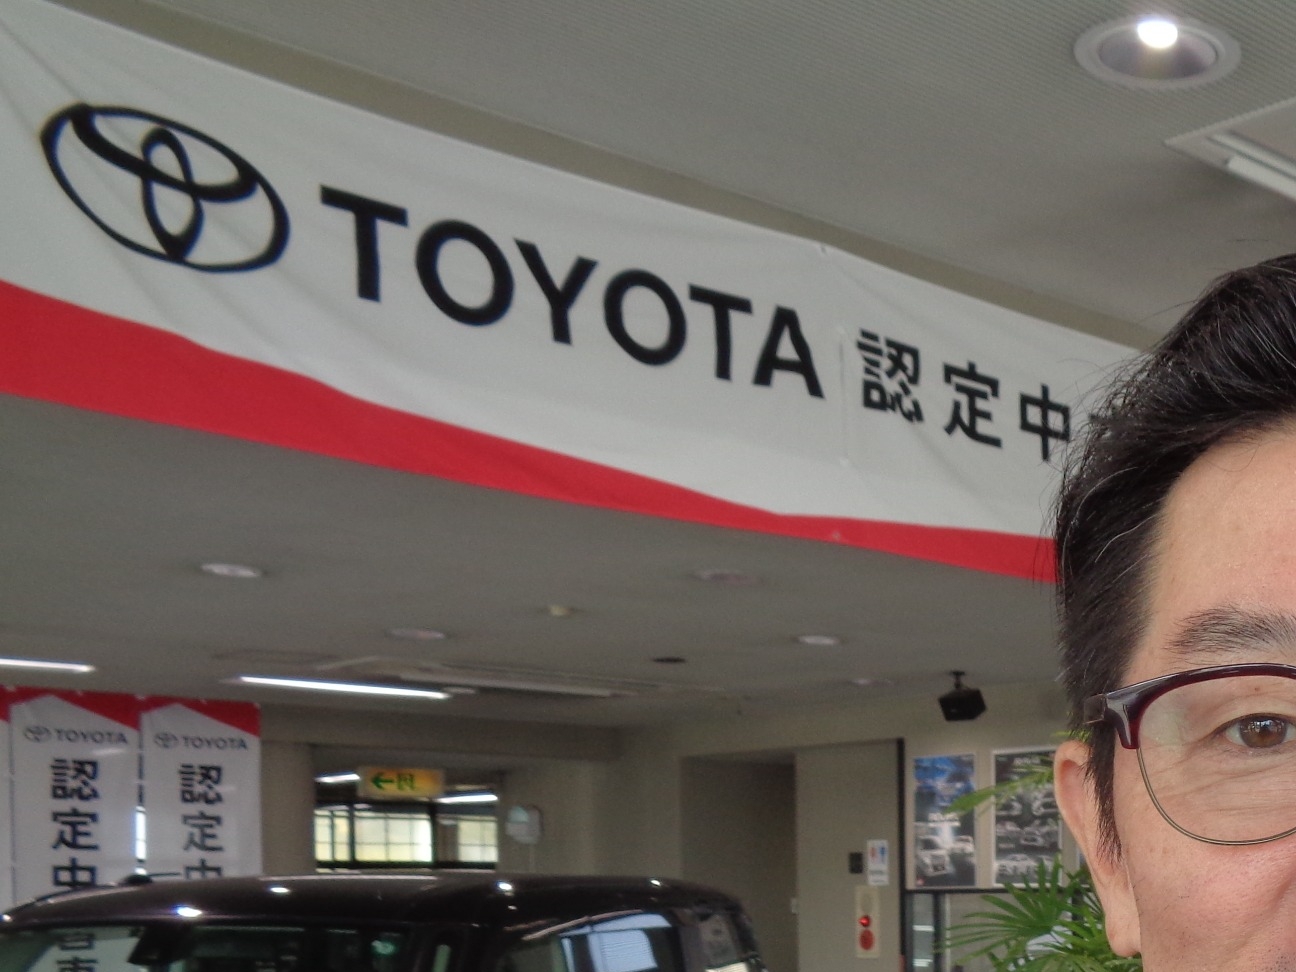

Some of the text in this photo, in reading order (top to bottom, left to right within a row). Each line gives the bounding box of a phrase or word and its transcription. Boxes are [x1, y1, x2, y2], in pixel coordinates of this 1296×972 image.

[319, 184, 825, 400] TOYOTA
[856, 327, 1104, 464] 認定中
[54, 727, 129, 745] TOYOTA
[182, 734, 248, 751] TOYOTA
